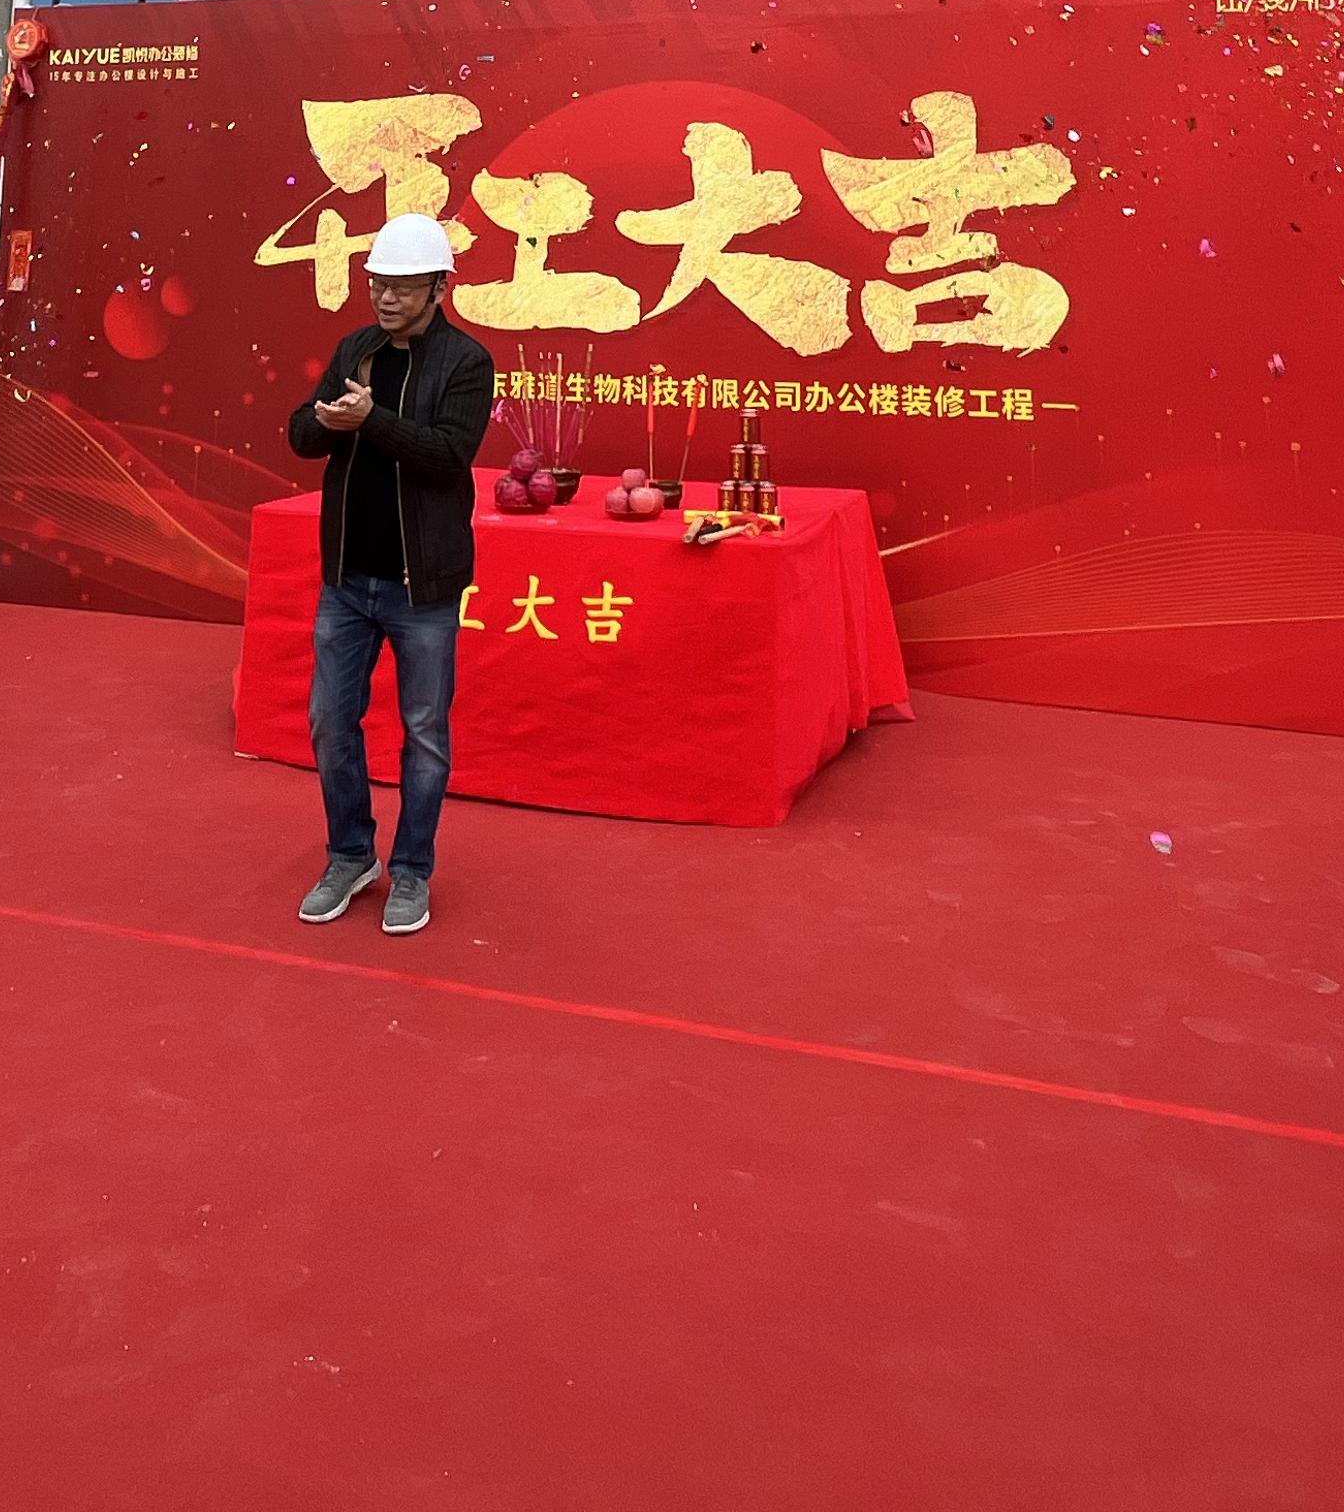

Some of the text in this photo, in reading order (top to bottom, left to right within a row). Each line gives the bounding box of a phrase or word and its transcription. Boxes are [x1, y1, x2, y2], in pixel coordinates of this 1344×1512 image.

[49, 47, 120, 65] KAIYUE
[254, 92, 1077, 358] 开工大吉
